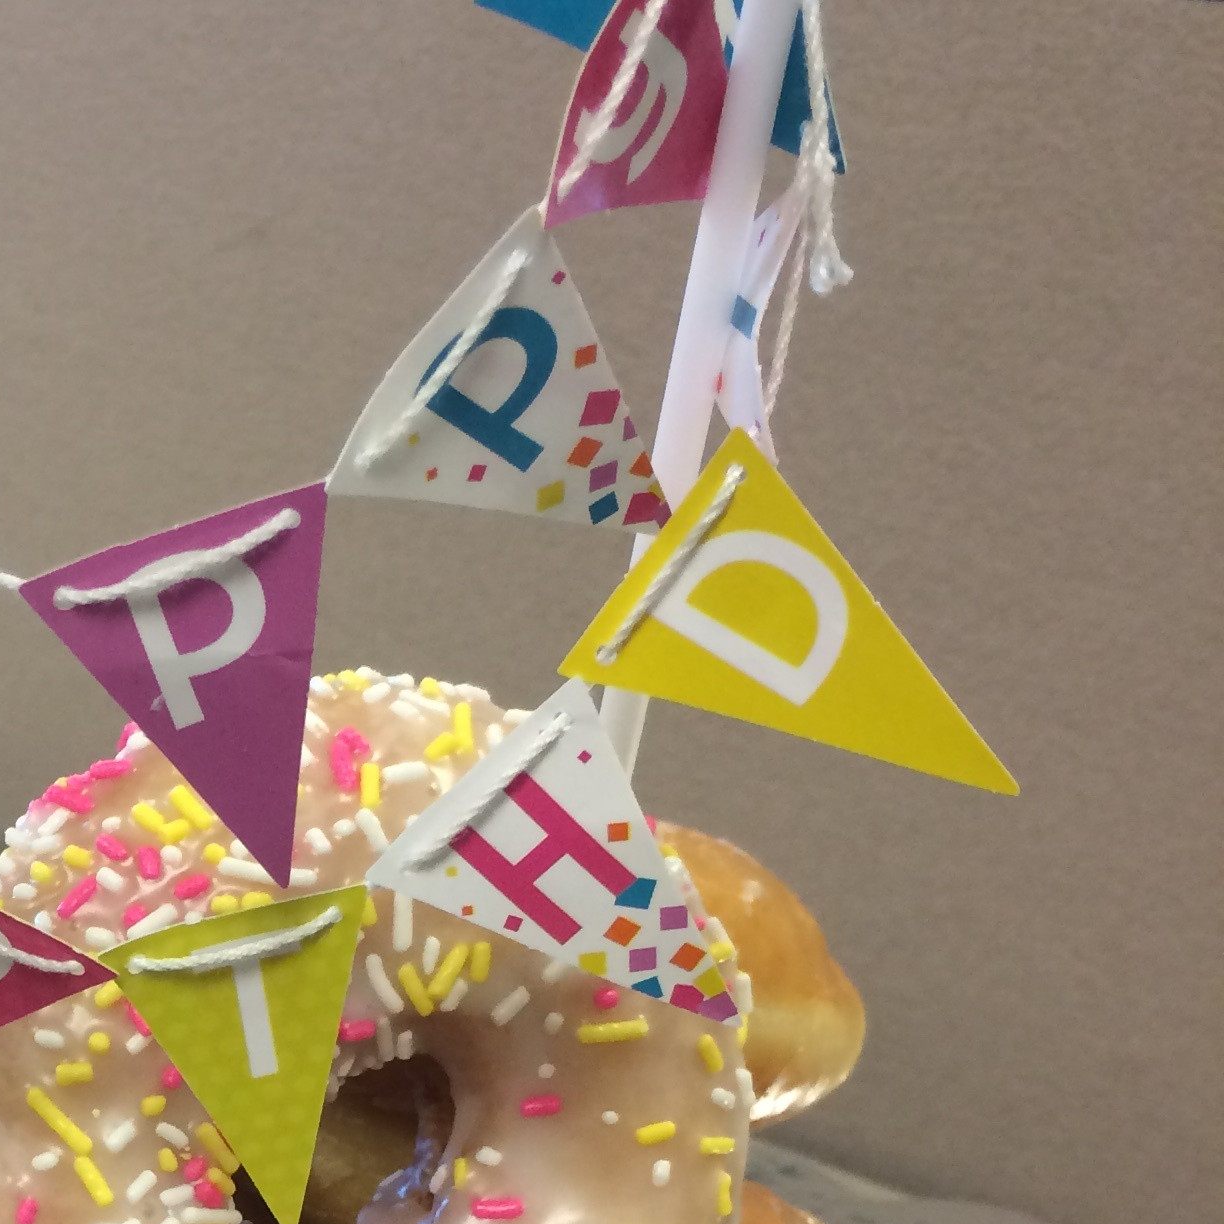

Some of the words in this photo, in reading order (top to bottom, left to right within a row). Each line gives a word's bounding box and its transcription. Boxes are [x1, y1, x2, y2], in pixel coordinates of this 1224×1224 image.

[414, 306, 558, 473] P
[124, 550, 267, 731] P
[650, 530, 849, 707] D
[448, 771, 639, 946] H
